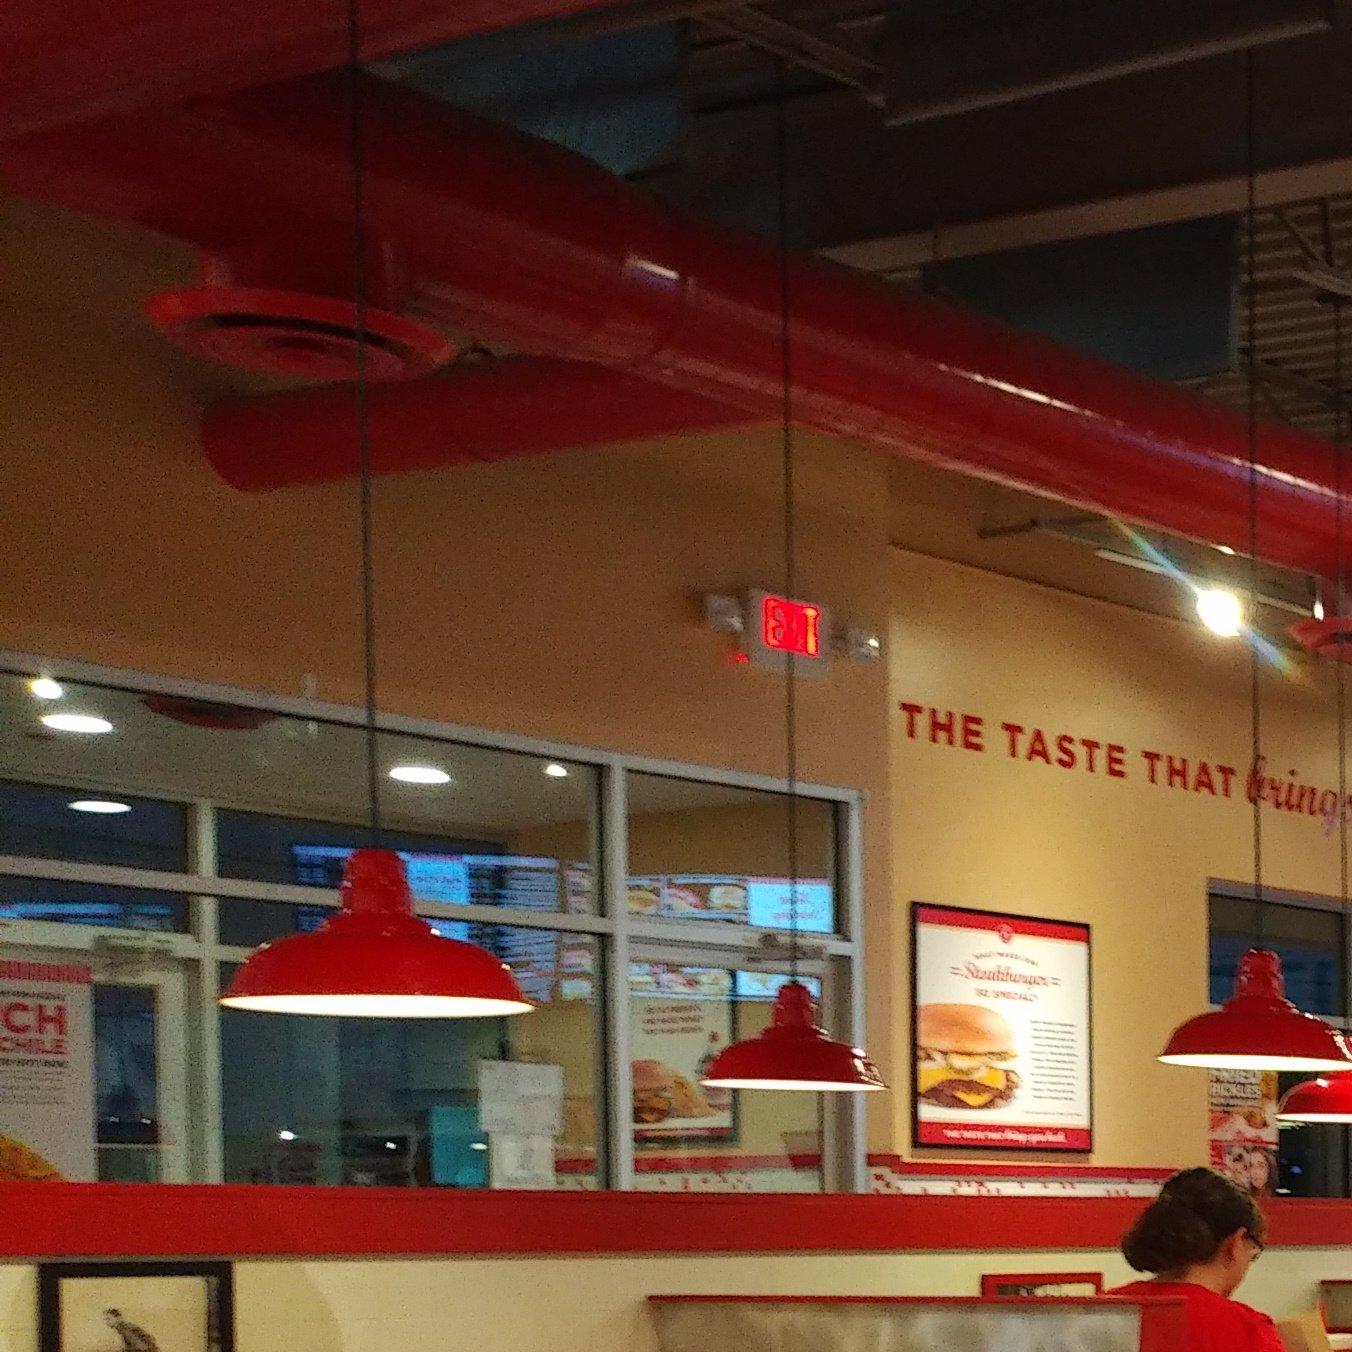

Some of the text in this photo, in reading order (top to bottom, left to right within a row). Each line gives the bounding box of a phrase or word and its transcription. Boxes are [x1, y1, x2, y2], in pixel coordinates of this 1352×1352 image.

[763, 597, 820, 656] ET
[899, 701, 985, 751] THE
[1001, 720, 1128, 779] TASTE
[1141, 750, 1237, 799] THAT
